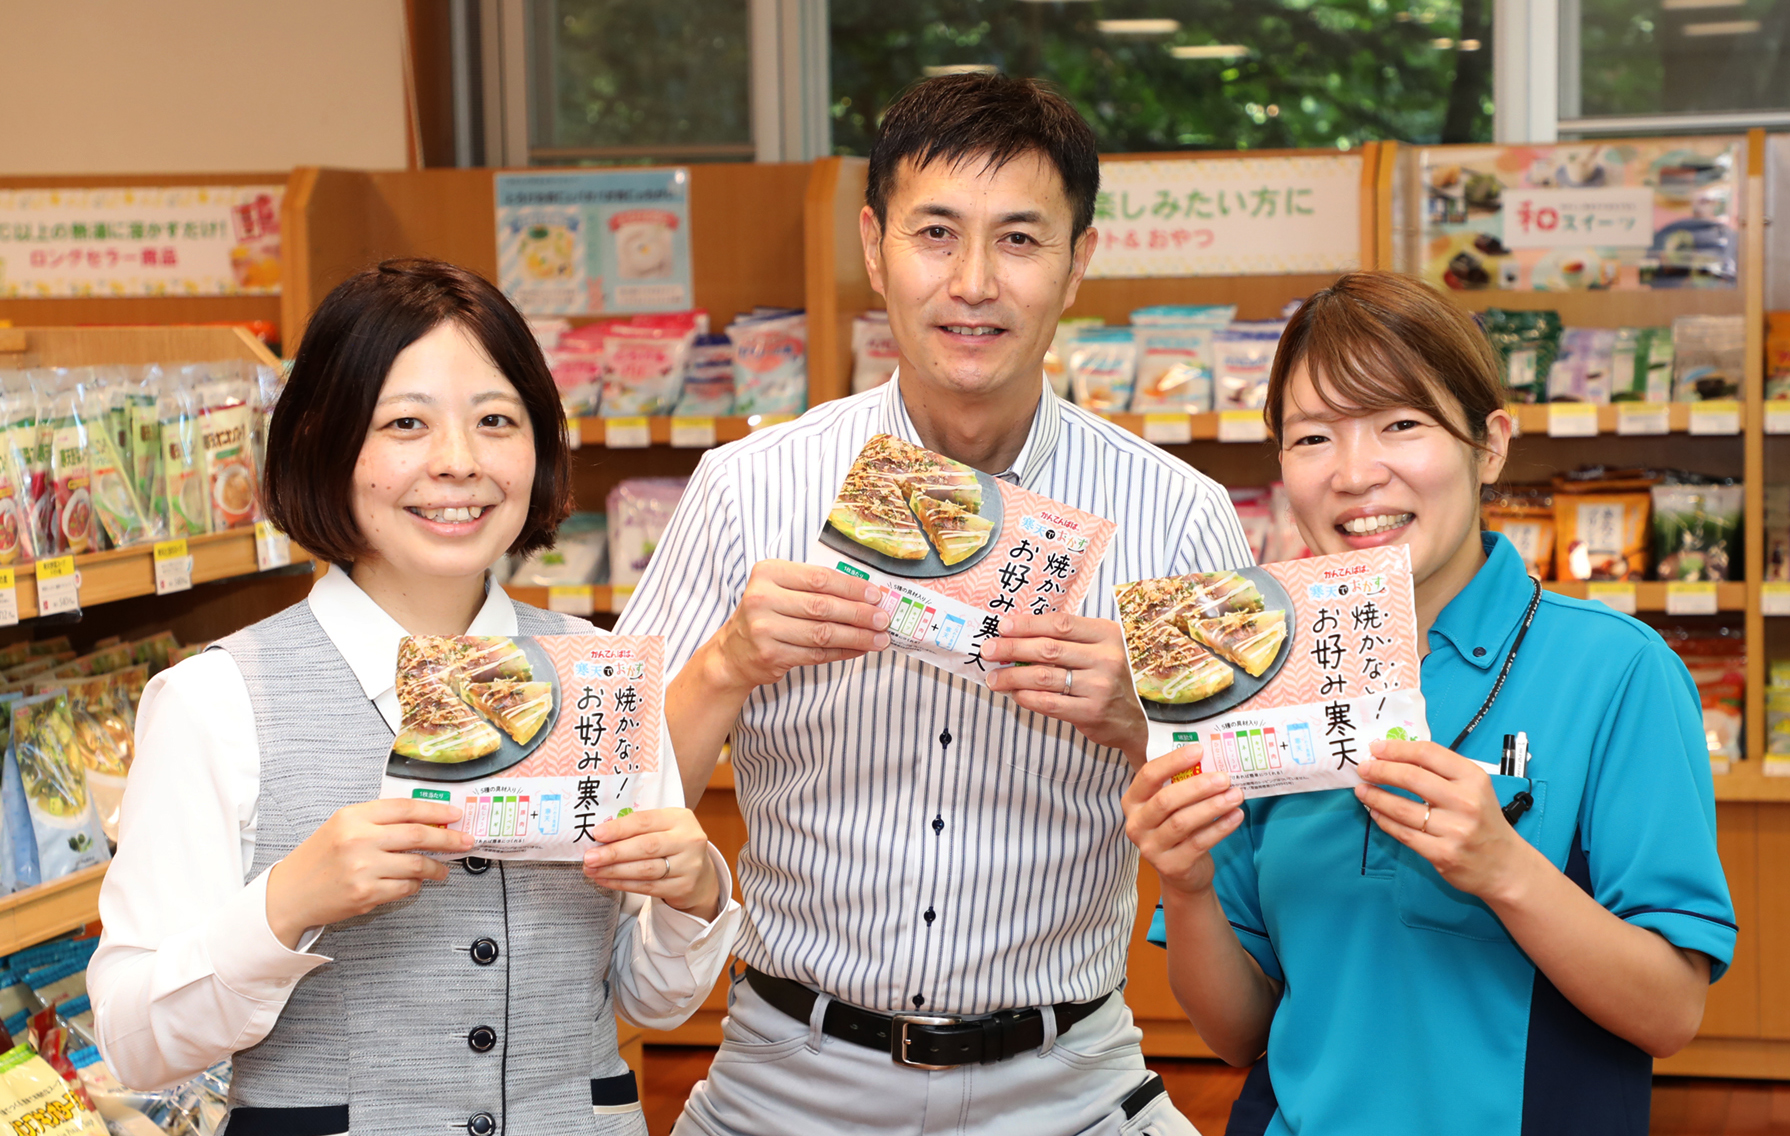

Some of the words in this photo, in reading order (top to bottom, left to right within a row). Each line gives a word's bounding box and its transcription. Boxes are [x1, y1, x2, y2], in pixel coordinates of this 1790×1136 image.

[573, 686, 607, 844] お好み寒天
[1311, 608, 1358, 770] お好み寒天
[419, 791, 444, 799] 1枚当たり
